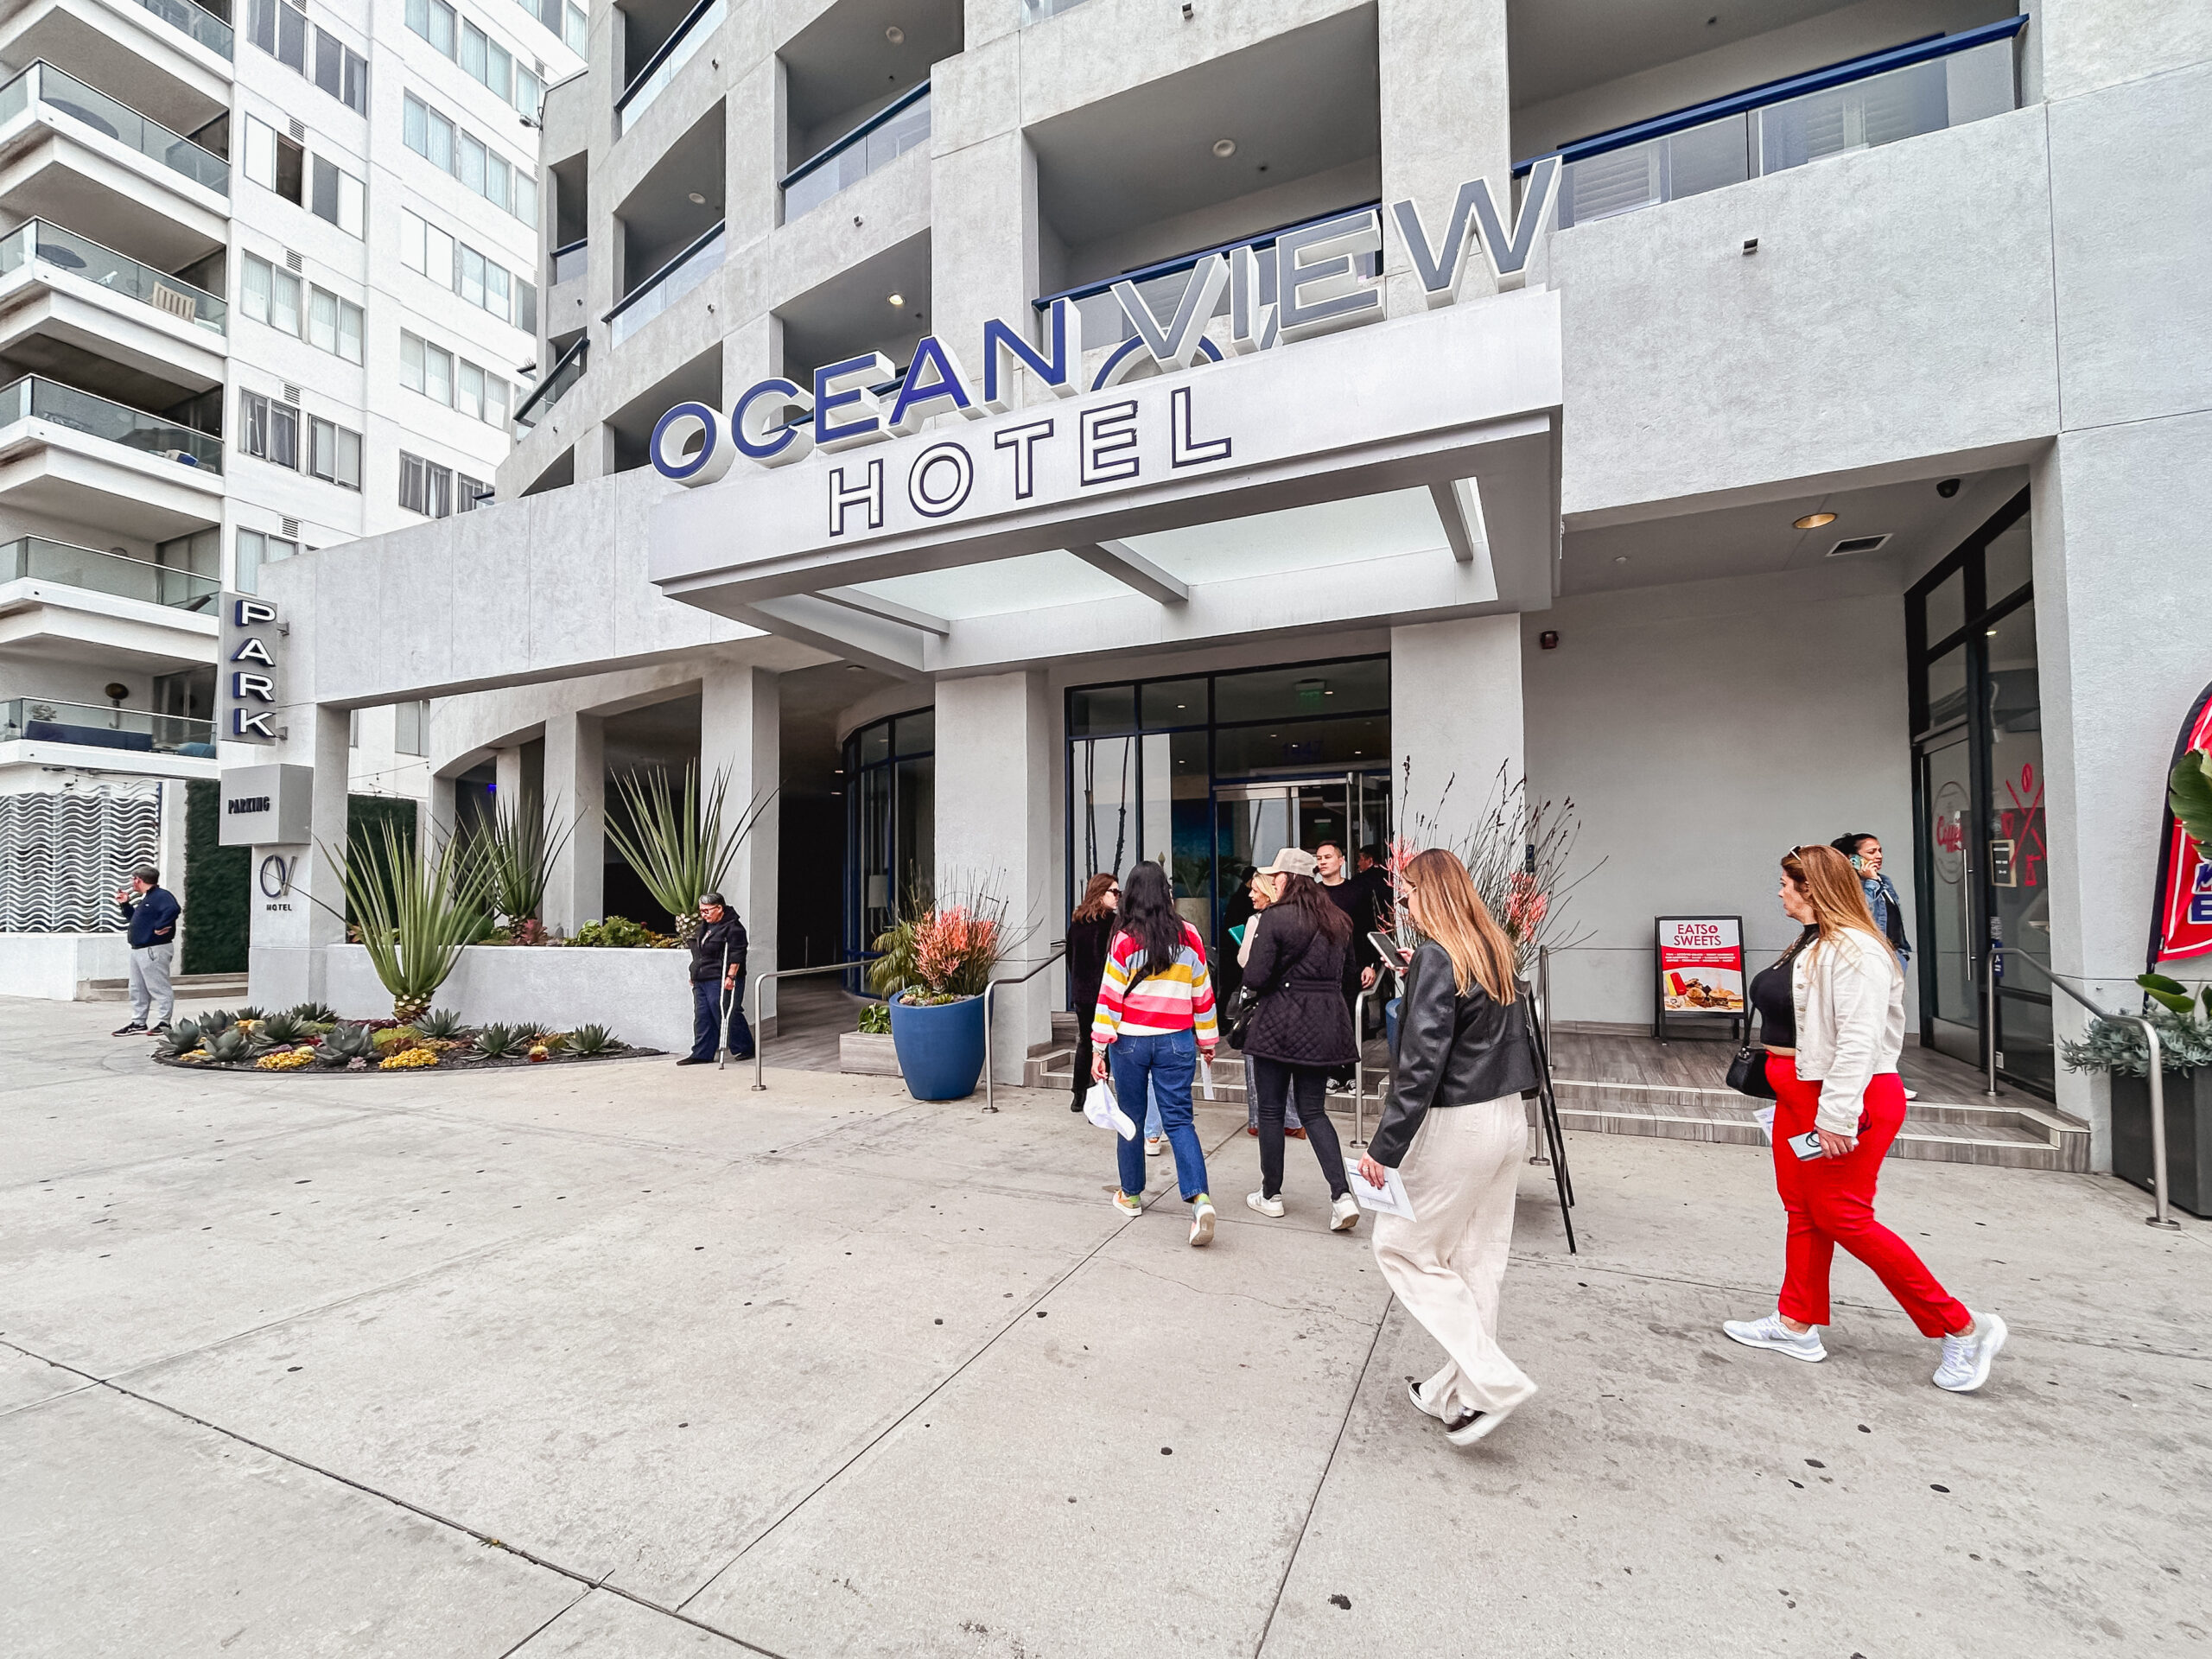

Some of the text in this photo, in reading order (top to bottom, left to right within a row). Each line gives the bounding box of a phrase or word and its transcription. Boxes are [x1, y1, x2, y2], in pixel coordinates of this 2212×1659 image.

[650, 155, 1562, 484] OCEAN VIEW
[829, 385, 1233, 537] HOTEL
[231, 599, 276, 738] PARK
[228, 797, 270, 814] PARKING
[1674, 935, 1721, 946] SWEETS
[1677, 924, 1708, 935] EATS
